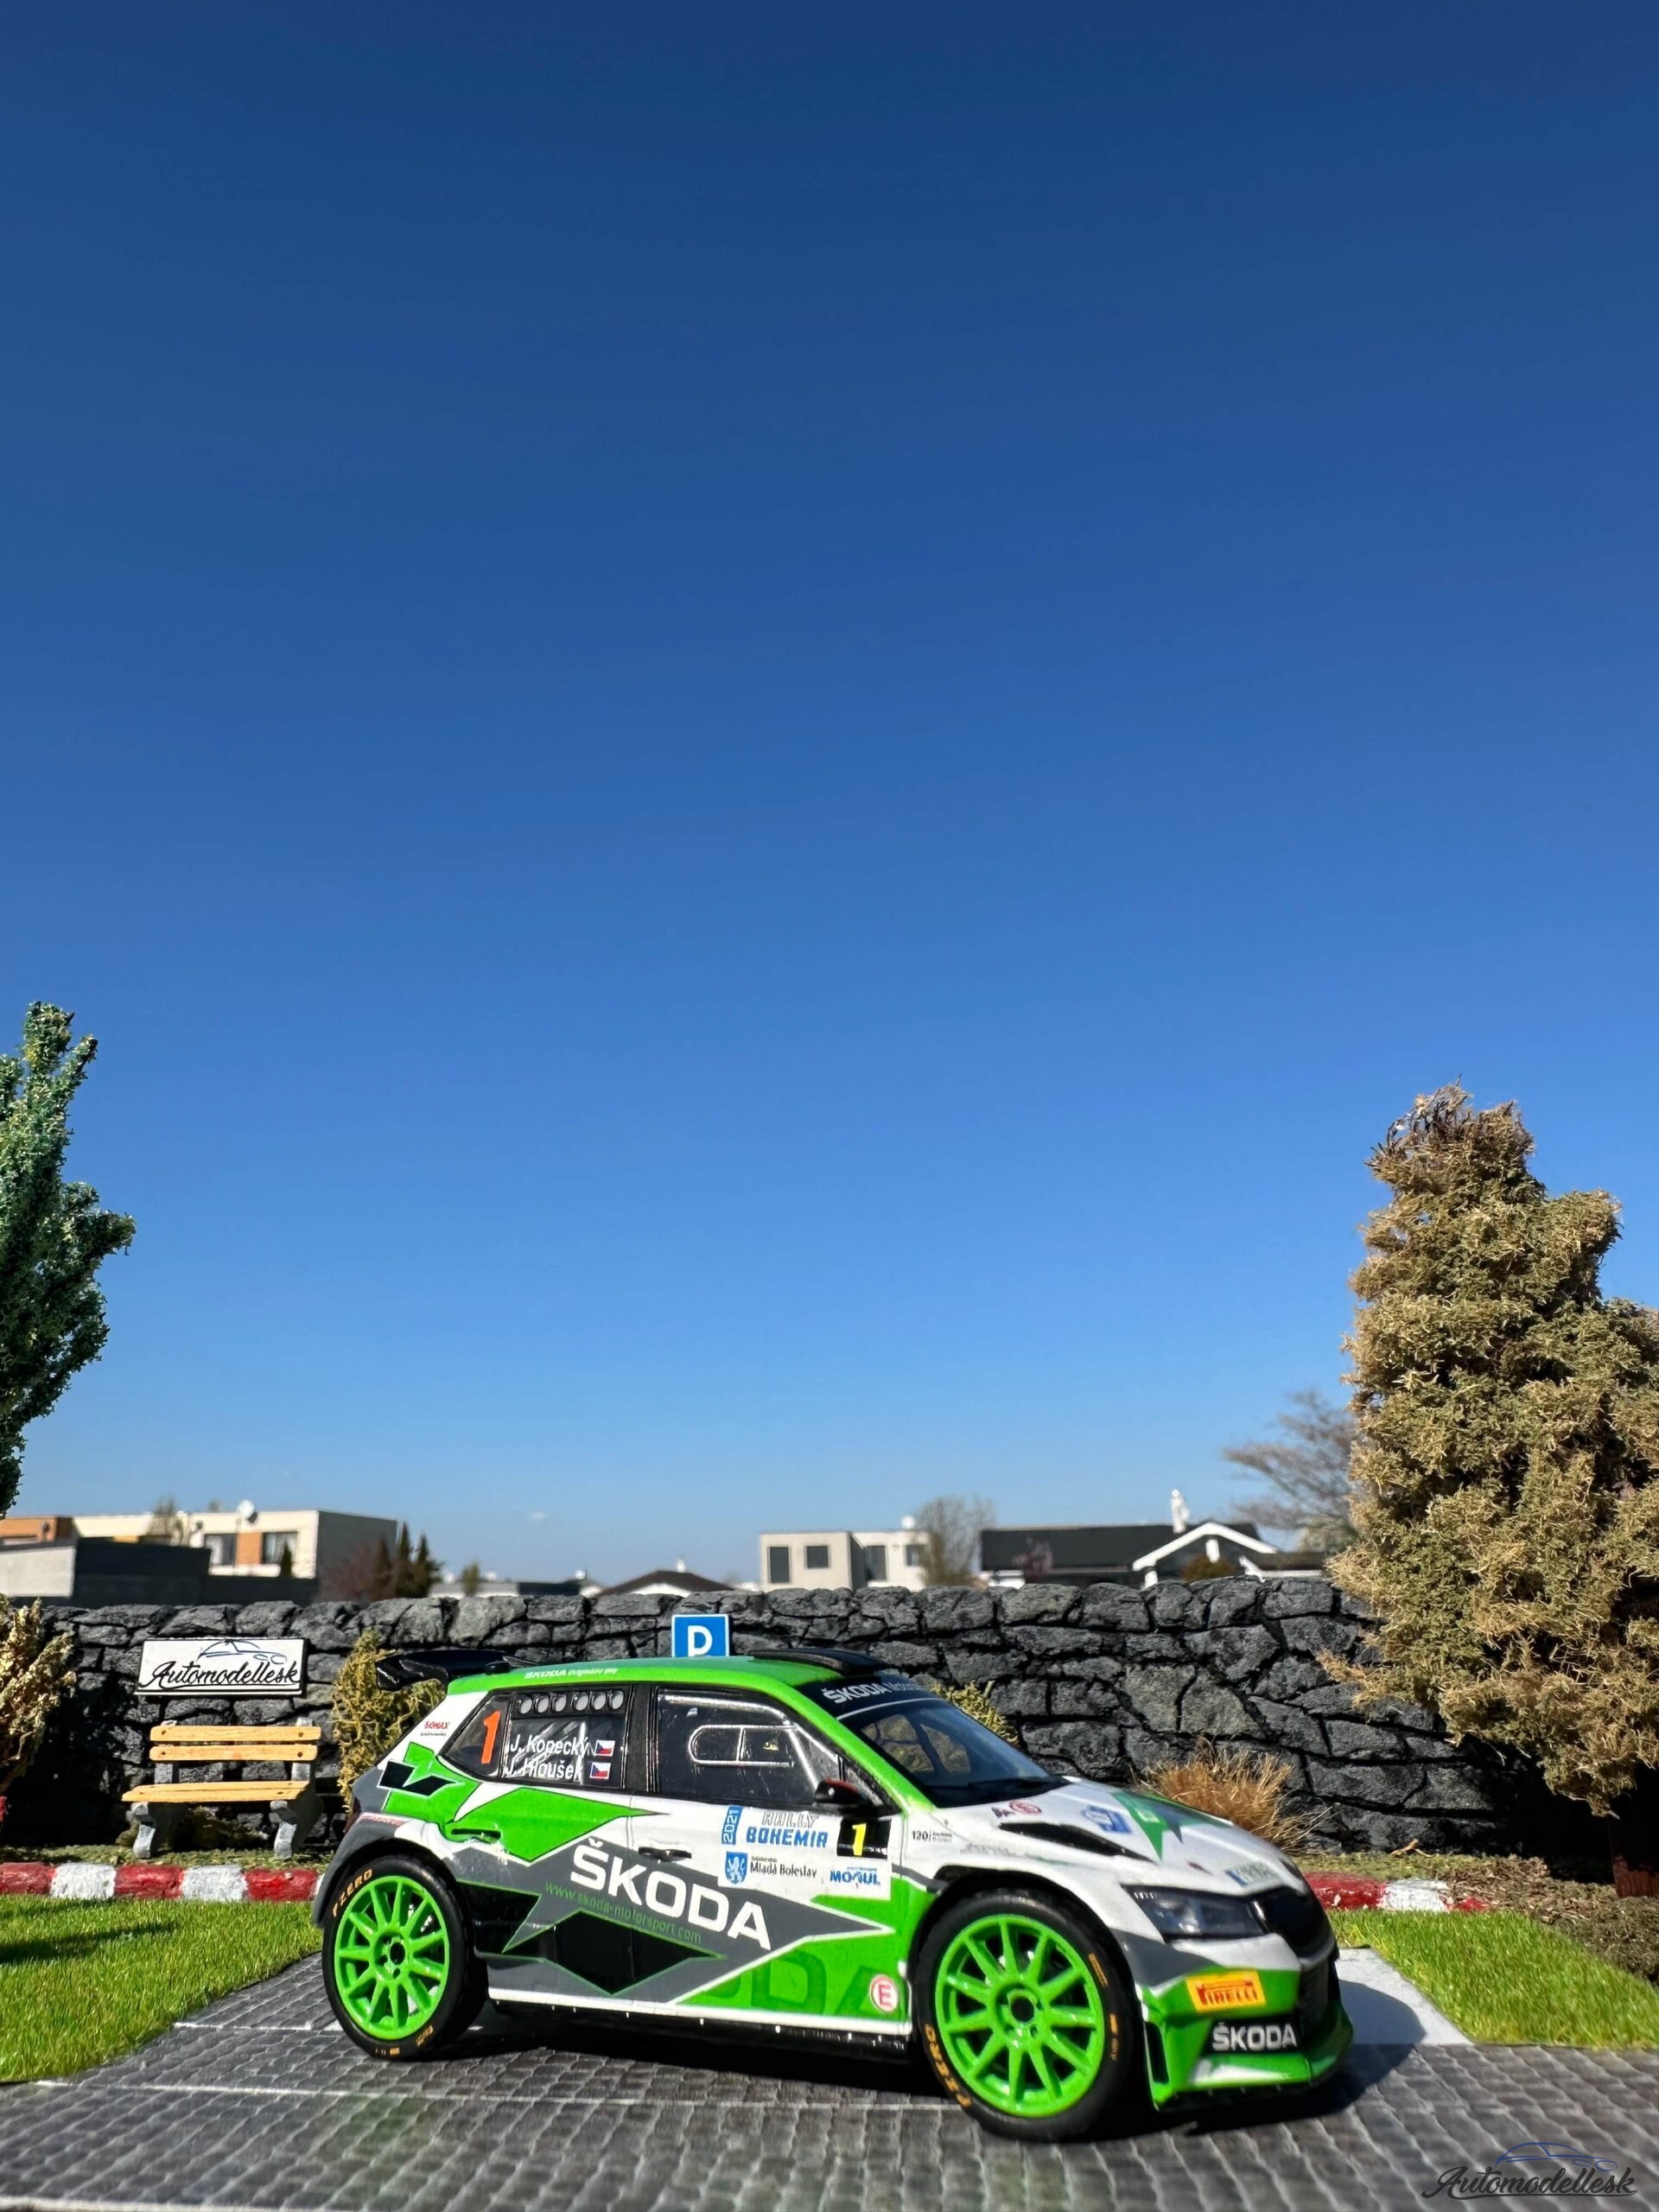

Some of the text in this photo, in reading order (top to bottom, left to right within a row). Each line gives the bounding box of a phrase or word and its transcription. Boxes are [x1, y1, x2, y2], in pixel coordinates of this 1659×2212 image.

[137, 1661, 302, 1690] Automodellesk
[480, 1710, 501, 1764] 1
[723, 1808, 739, 1845] 2021
[761, 1811, 820, 1828] RALLY
[852, 1822, 867, 1857] 1
[569, 1835, 772, 1951] ŠKODA
[878, 1984, 893, 2007] E
[1211, 2021, 1298, 2052] ŠKODA
